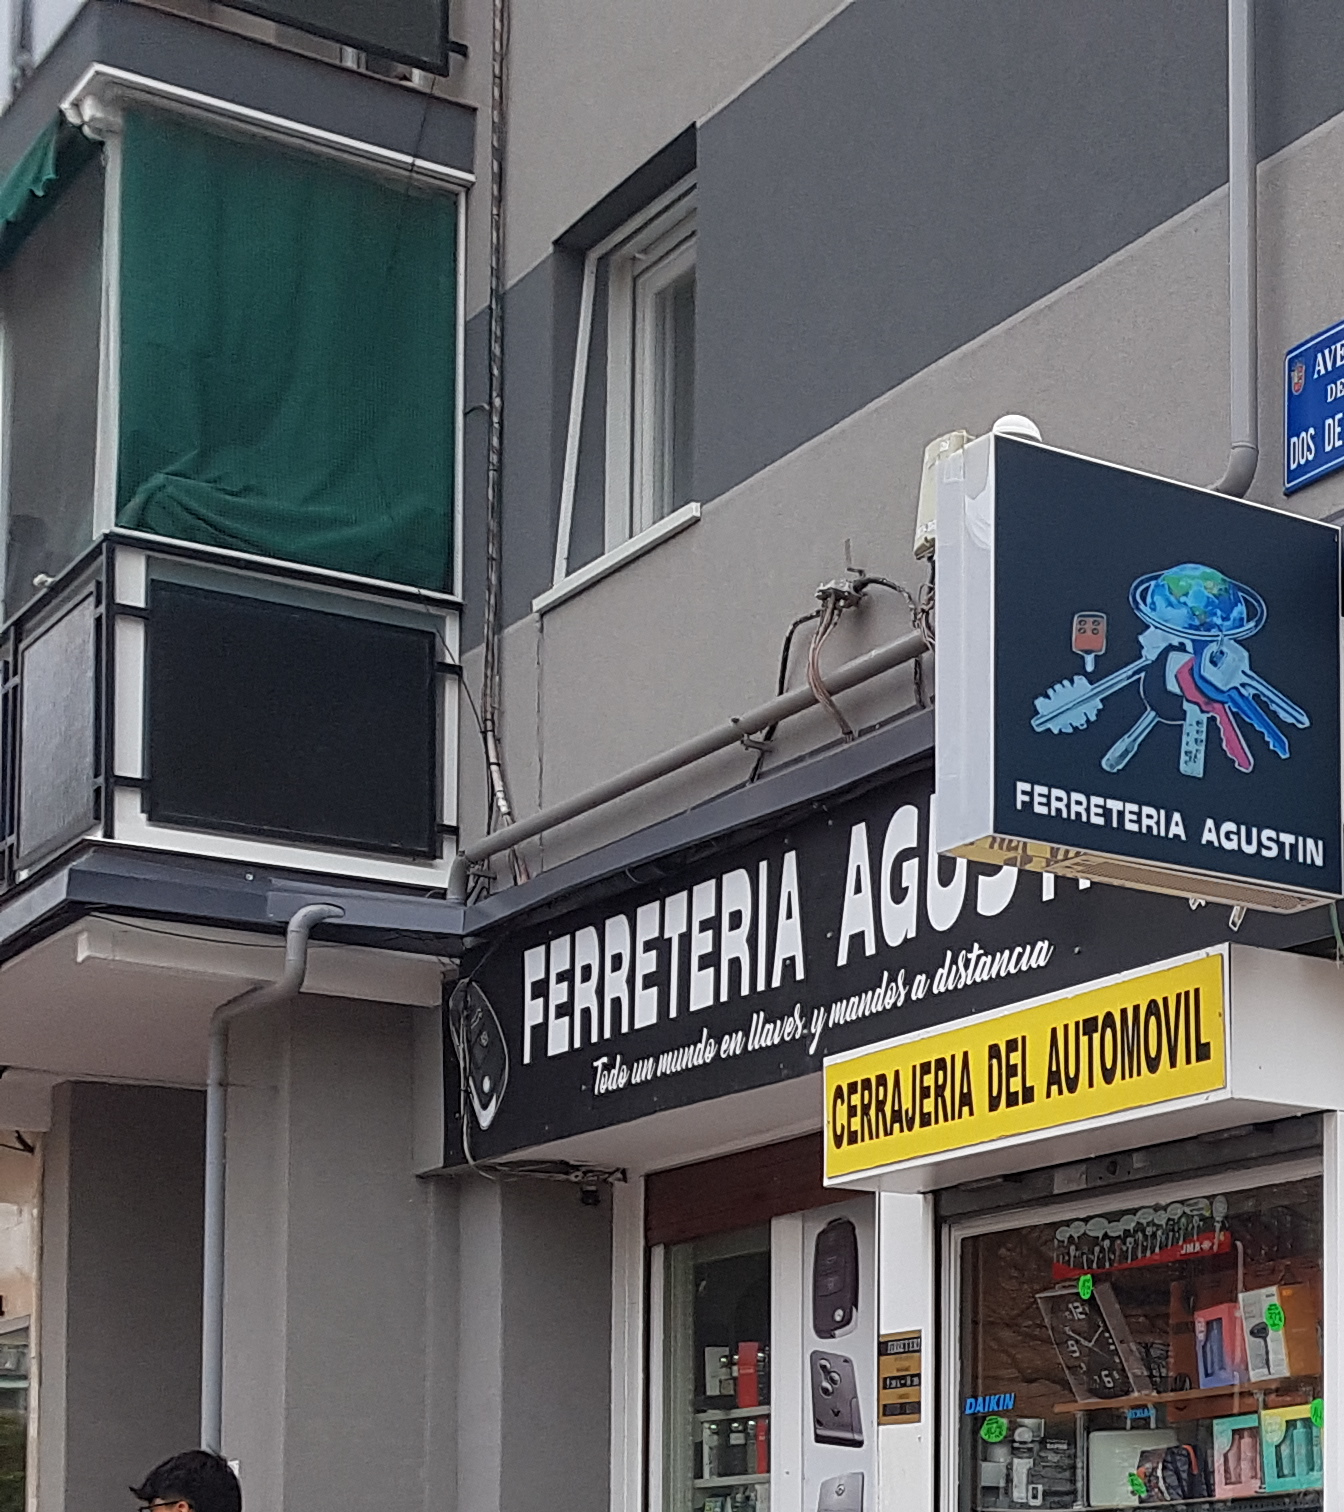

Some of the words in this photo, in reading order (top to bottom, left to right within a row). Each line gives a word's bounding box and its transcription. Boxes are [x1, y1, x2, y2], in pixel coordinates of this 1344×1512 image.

[1290, 427, 1315, 470] DOS
[1325, 412, 1343, 452] DE
[1015, 781, 1187, 842] FERRETERIA
[1201, 818, 1324, 867] AGUSTIN
[523, 850, 804, 1064] FERRETERIA
[593, 1054, 630, 1096] Todo
[631, 1058, 655, 1084] un
[657, 1028, 718, 1075] mundo
[720, 1030, 745, 1059] en
[747, 1003, 806, 1050] llaves
[809, 1006, 826, 1055] y
[829, 968, 909, 1027] mandos
[910, 974, 930, 1001] a
[931, 938, 1055, 996] distancia
[831, 1050, 975, 1149] CERRAJERIA
[987, 1035, 1035, 1113] DEL
[1045, 987, 1212, 1099] AUTOMOVIL
[964, 1393, 1016, 1415] DAIKIN
